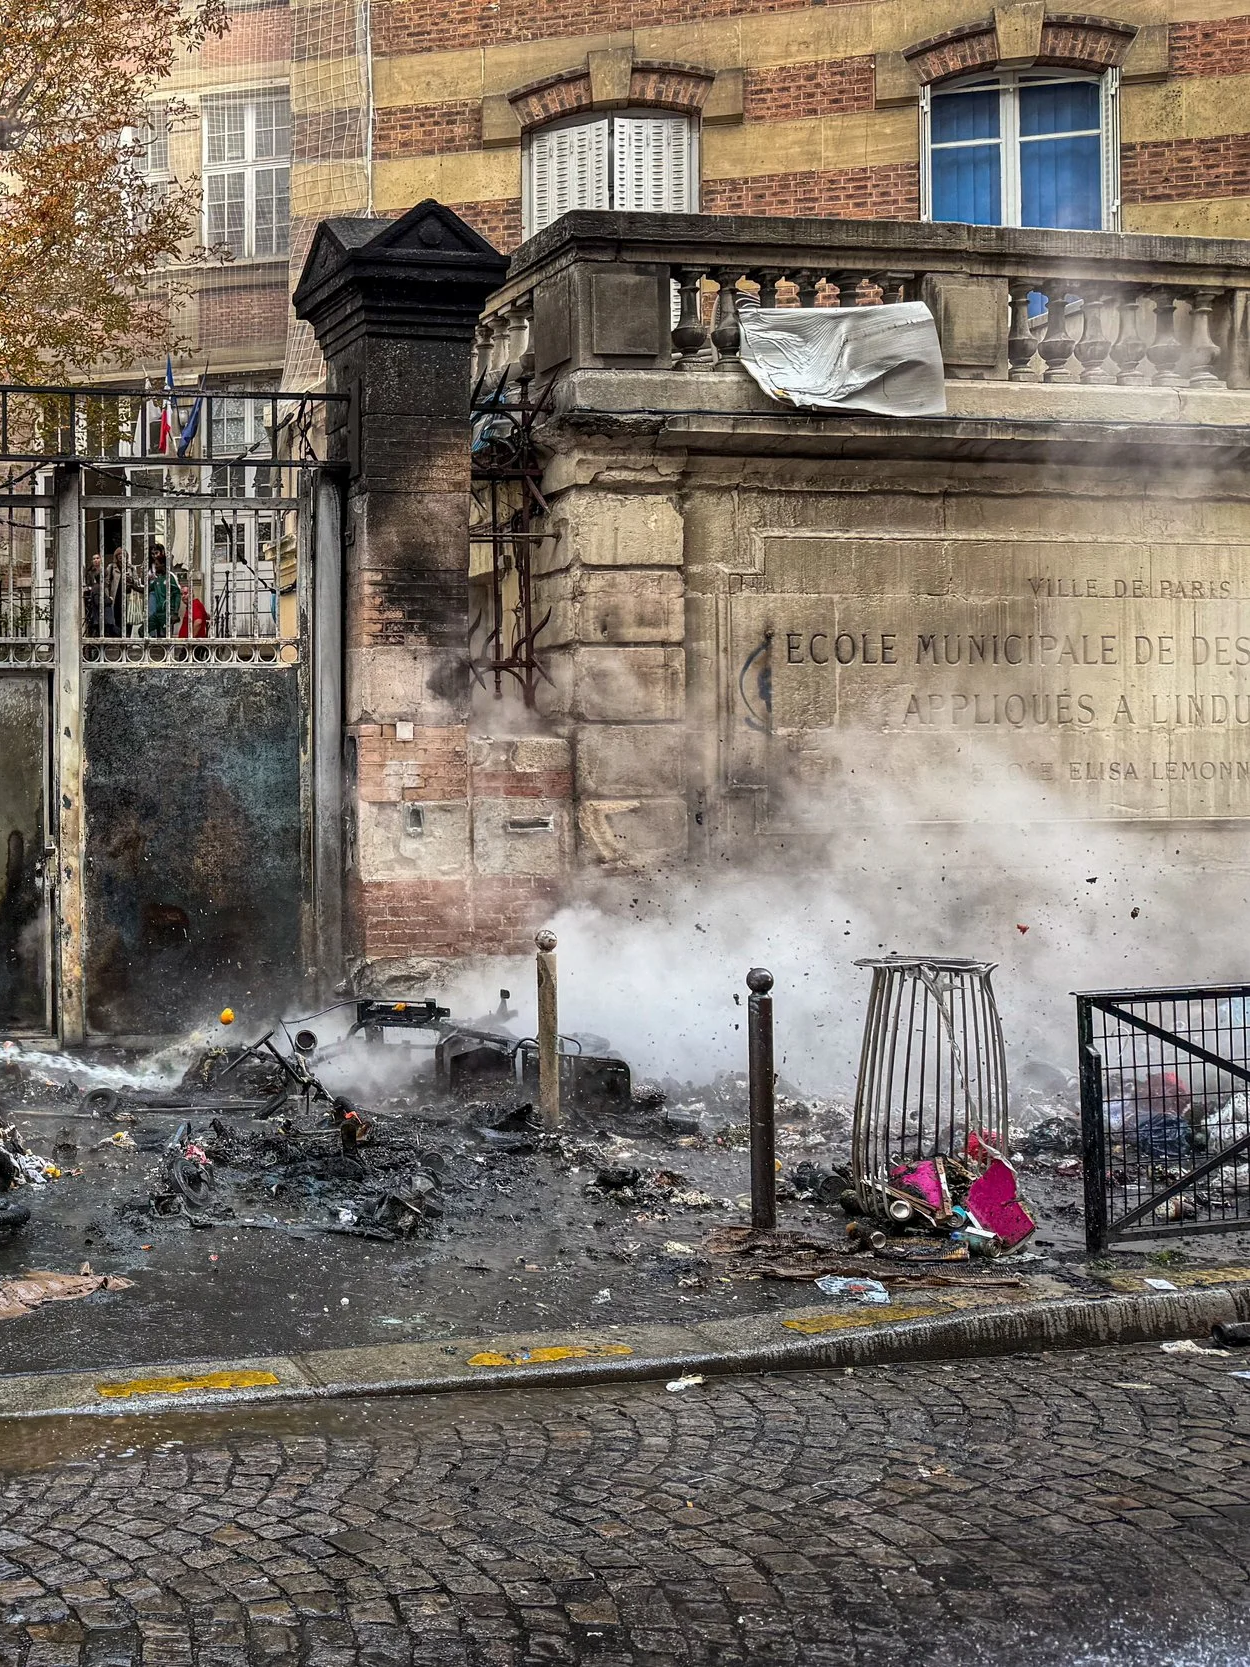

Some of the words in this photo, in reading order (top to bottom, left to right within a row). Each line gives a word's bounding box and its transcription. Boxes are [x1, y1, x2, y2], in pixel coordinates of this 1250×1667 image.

[1027, 578, 1098, 599] VILLE
[1114, 579, 1144, 598] DE
[1160, 580, 1231, 599] PARIS
[915, 633, 1118, 666] MUNICIPALE
[1134, 634, 1175, 666] DE
[1191, 635, 1250, 666] DES
[1069, 761, 1140, 781] ELISA
[1151, 761, 1250, 781] LEMONN
